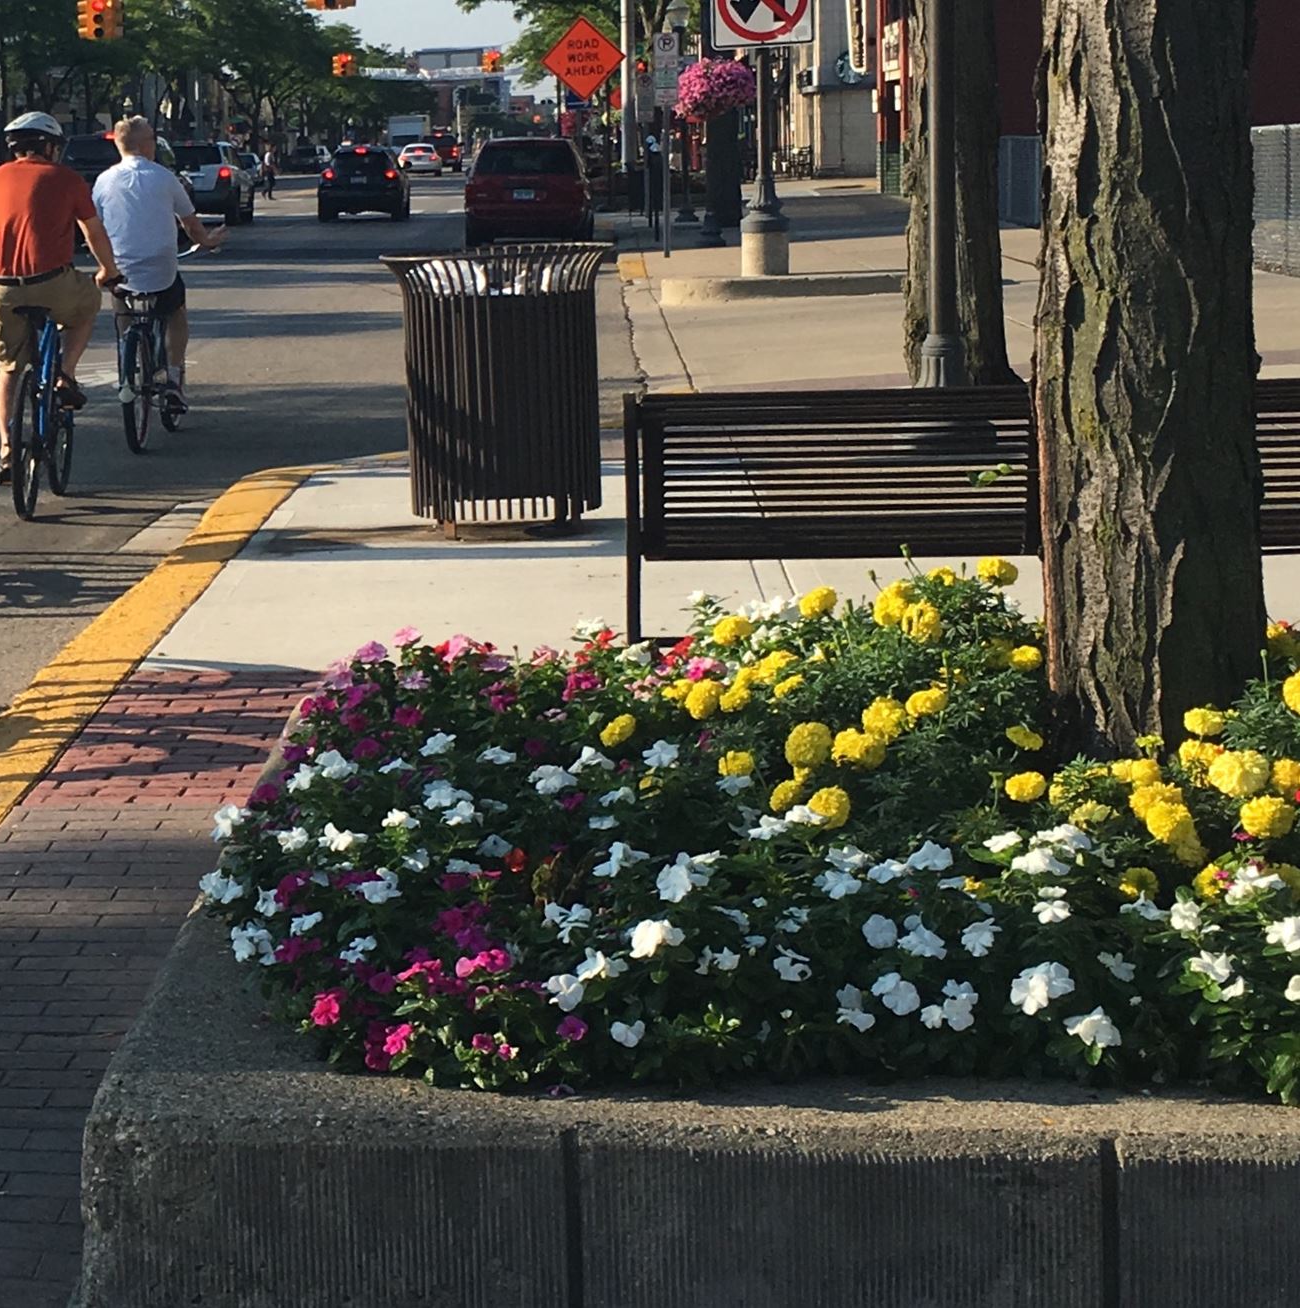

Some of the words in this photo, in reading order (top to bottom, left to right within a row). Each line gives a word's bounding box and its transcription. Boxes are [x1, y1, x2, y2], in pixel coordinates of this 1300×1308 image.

[567, 38, 599, 50] ROAD
[567, 51, 599, 63] WORK
[565, 64, 604, 77] AHEAD
